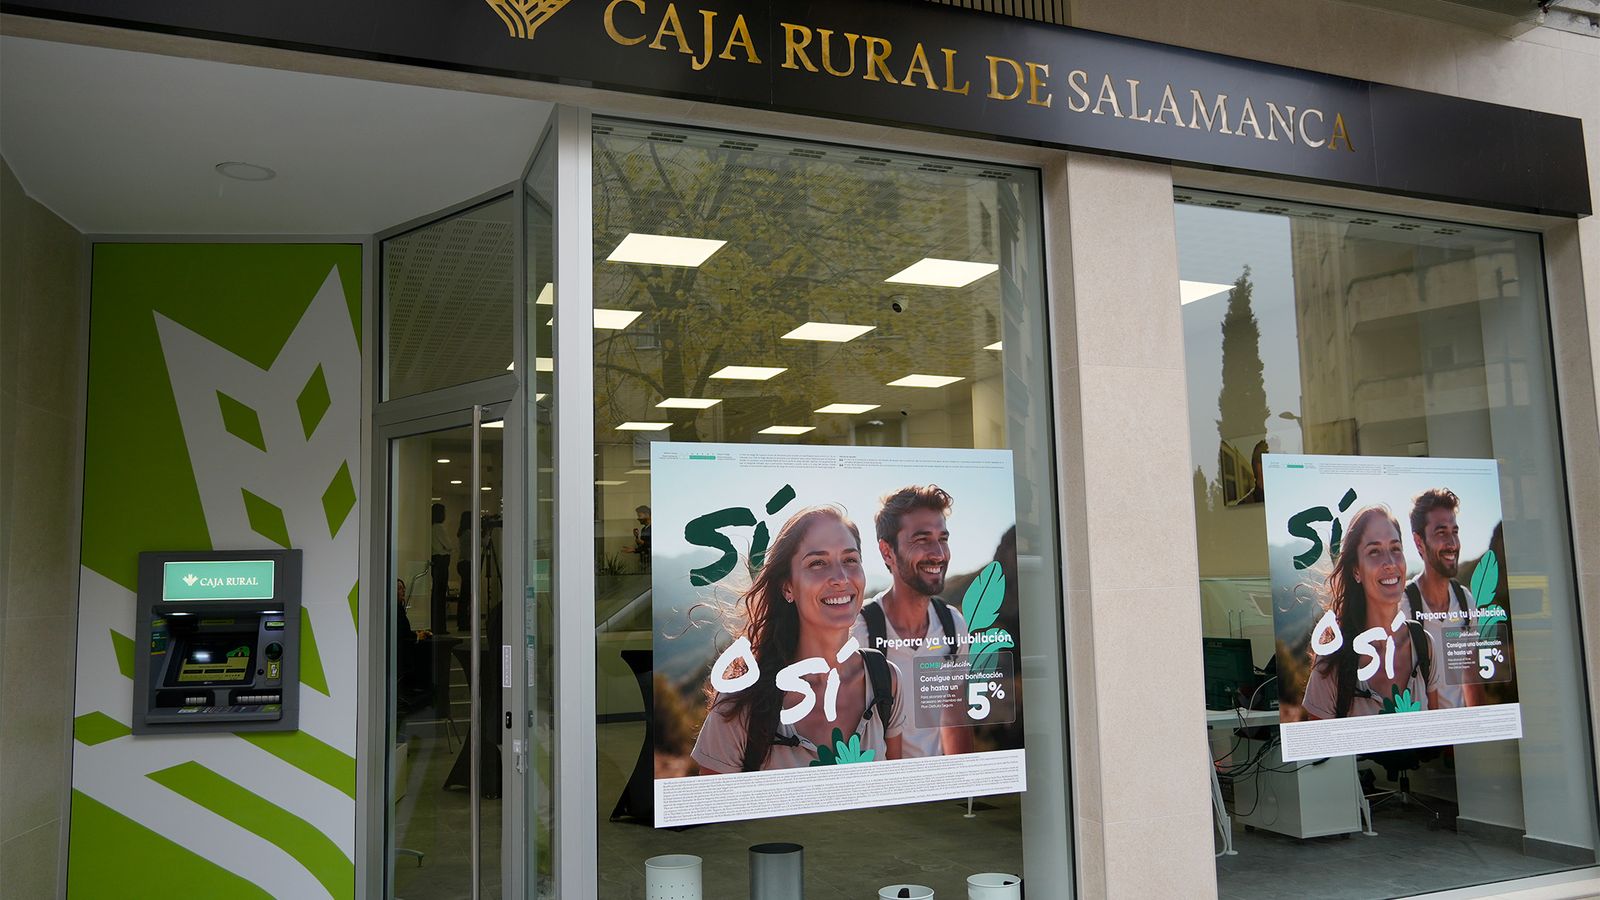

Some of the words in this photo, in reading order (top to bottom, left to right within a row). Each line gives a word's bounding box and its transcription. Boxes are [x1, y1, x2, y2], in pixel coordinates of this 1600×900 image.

[602, 0, 762, 70] CAJA
[779, 22, 970, 96] RURAL
[985, 55, 1053, 108] DE
[1067, 69, 1356, 152] SALAMANCA
[200, 577, 225, 589] CAJA
[226, 576, 259, 586] RURAL
[1415, 610, 1447, 621] Prepara
[1449, 612, 1458, 620] ya
[1460, 610, 1468, 618] tu
[1469, 608, 1506, 620] jubilación
[875, 636, 923, 650] Prepara
[926, 639, 940, 648] ya
[943, 635, 955, 645] tu
[957, 632, 1012, 647] jubilación
[1479, 647, 1504, 679] 5%
[920, 675, 951, 683] Consigue
[965, 671, 1004, 680] bonificación
[931, 684, 948, 692] hasta
[967, 681, 1006, 720] 5%
